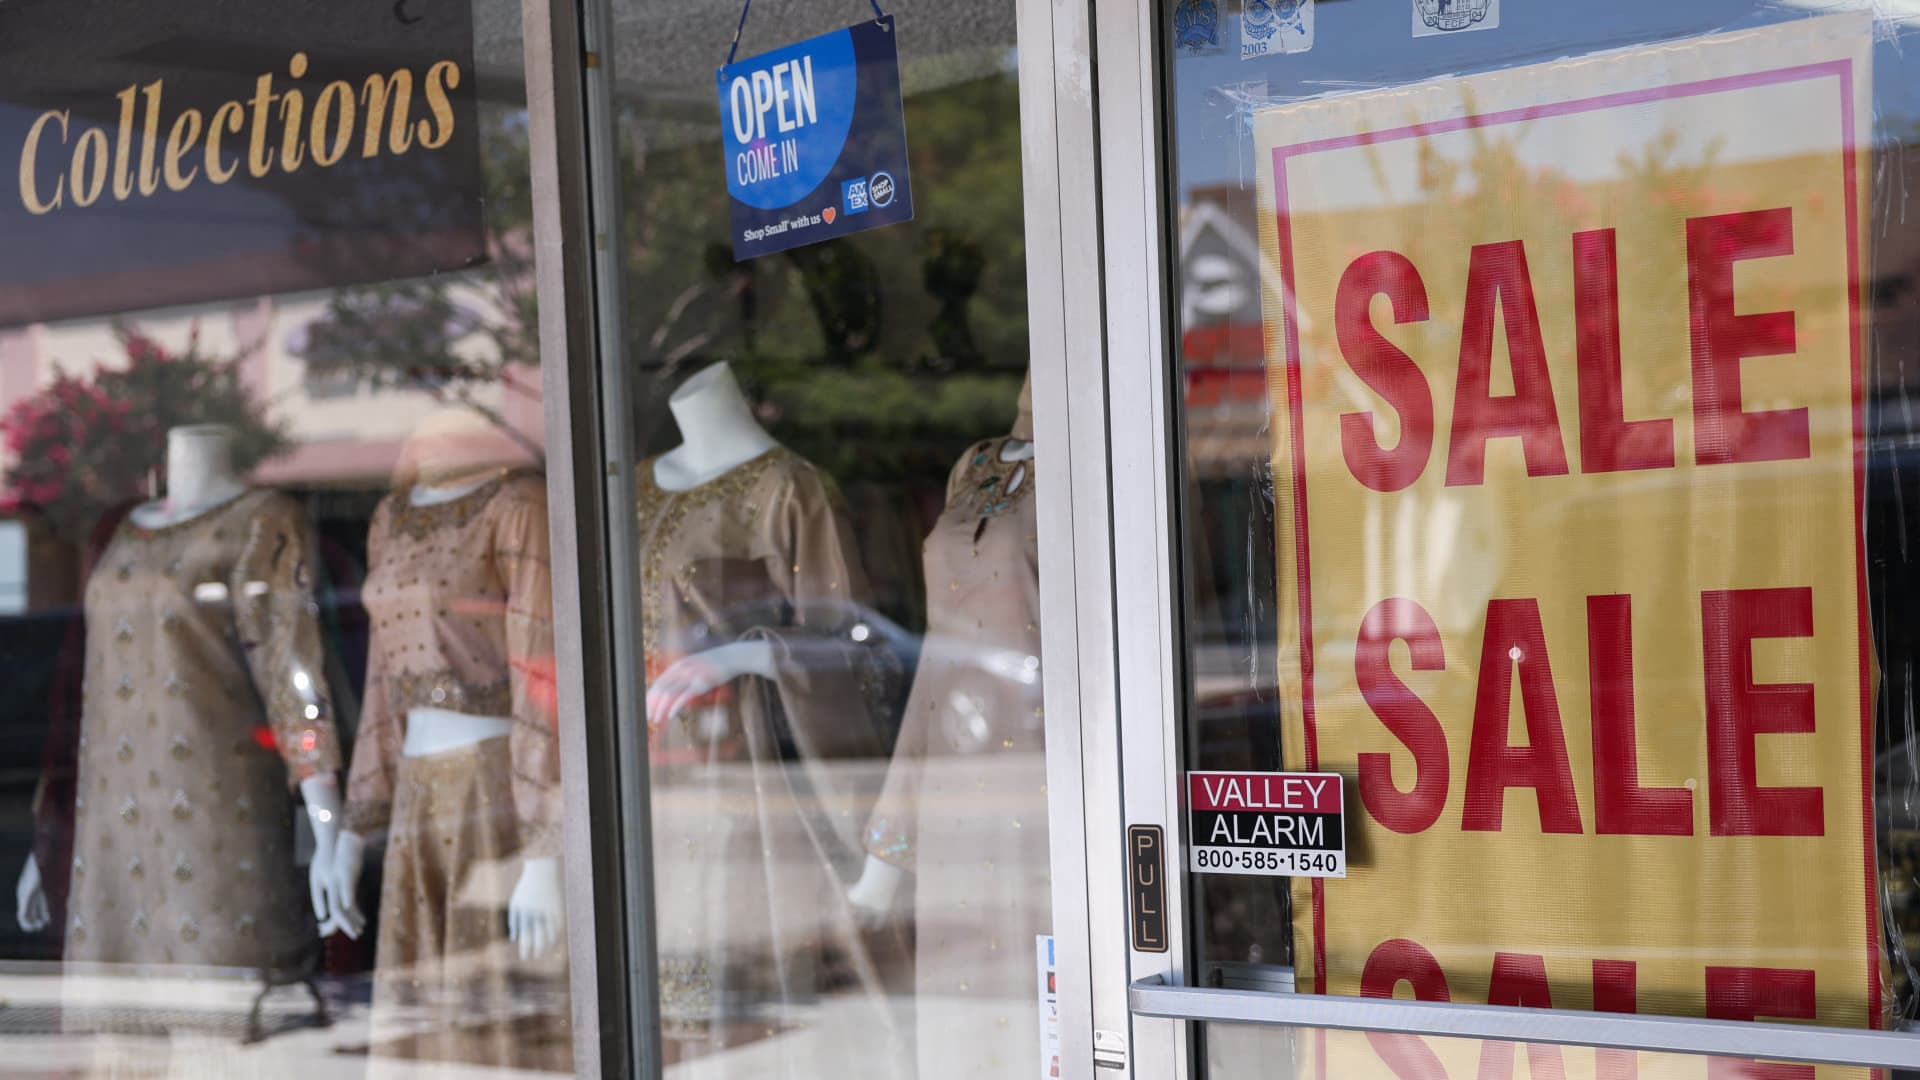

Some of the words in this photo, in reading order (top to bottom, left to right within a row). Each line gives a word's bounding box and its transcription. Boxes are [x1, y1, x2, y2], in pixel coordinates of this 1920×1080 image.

[1242, 42, 1267, 56] 2003
[19, 52, 460, 215] Collections
[730, 55, 817, 144] OPEN
[736, 143, 780, 187] COME
[781, 138, 799, 175] IN
[744, 229, 764, 242] Shop
[790, 215, 810, 230] with
[810, 214, 822, 225] us
[1334, 207, 1810, 492] SALE
[1355, 586, 1825, 837] SALE
[1203, 778, 1327, 809] VALLEY
[1210, 814, 1324, 846] ALARM
[1137, 835, 1157, 942] PULL
